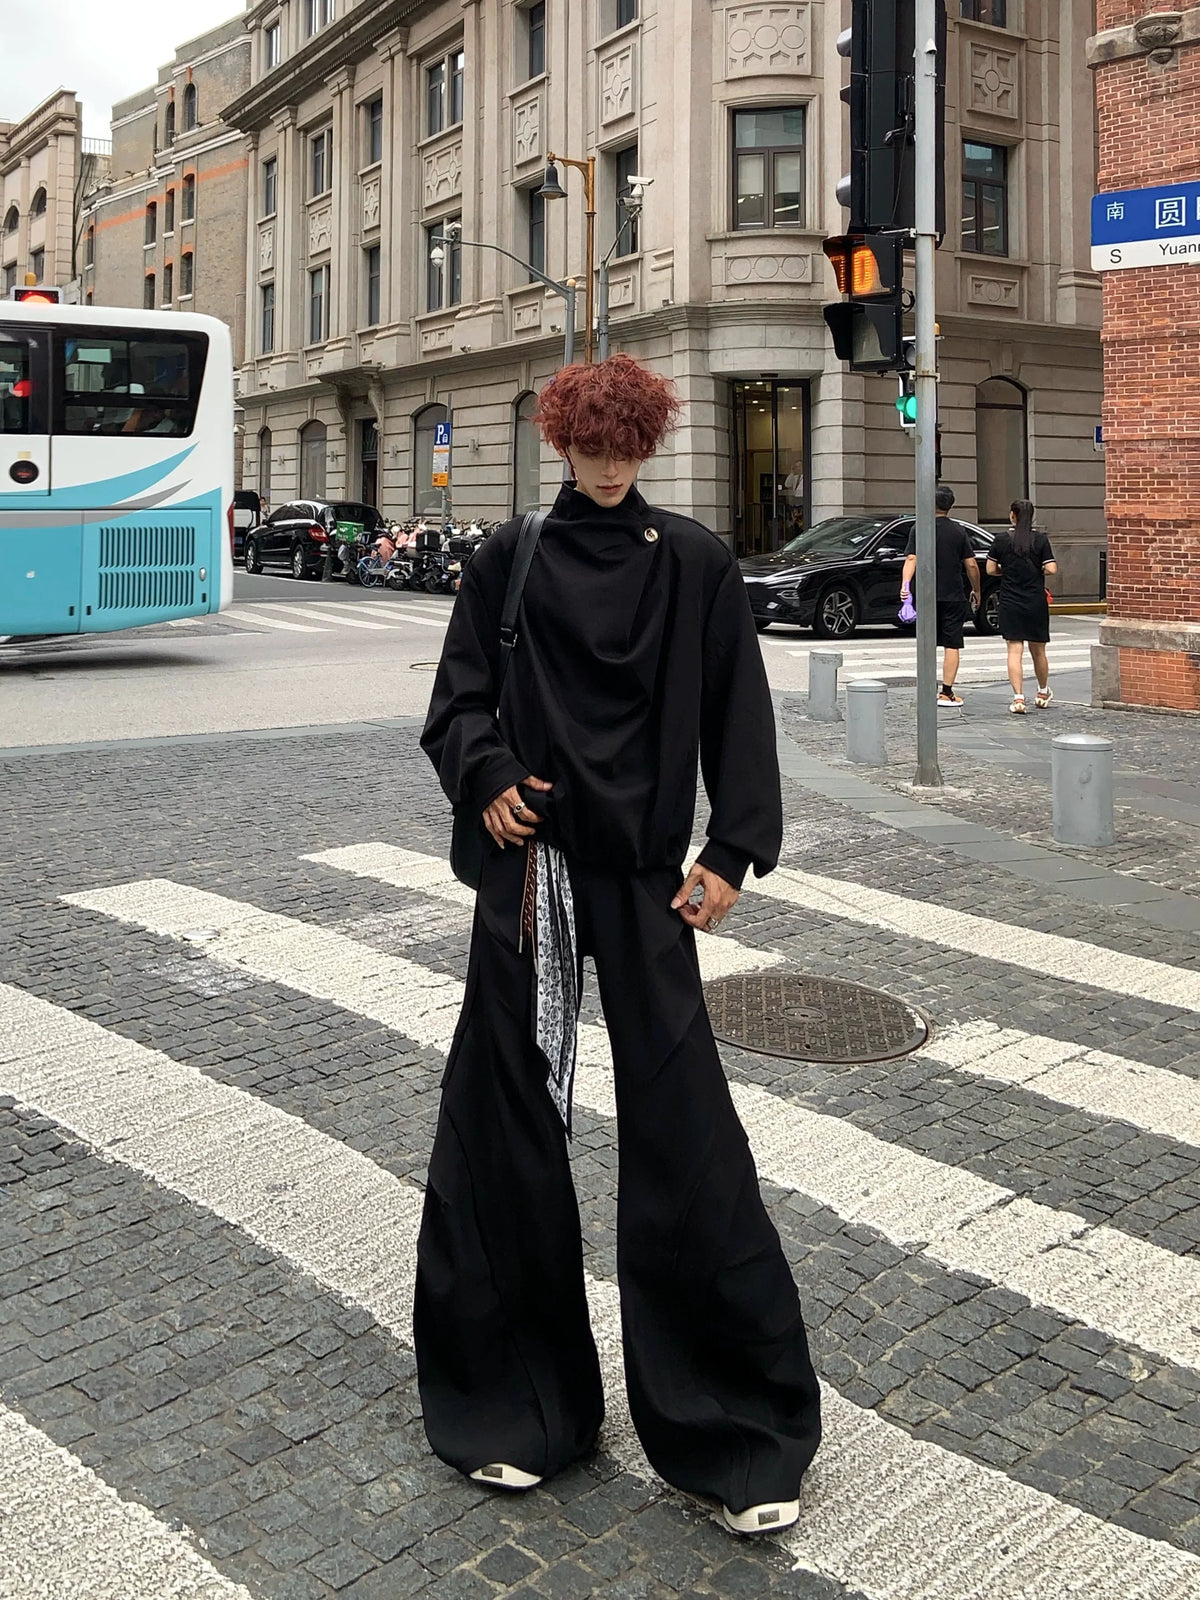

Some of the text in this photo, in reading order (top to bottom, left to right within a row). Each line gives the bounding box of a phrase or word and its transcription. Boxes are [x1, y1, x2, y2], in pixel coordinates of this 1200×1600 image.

[1106, 196, 1200, 229] 南 圆
[1110, 243, 1200, 264] S Yuan
[436, 424, 445, 445] P
